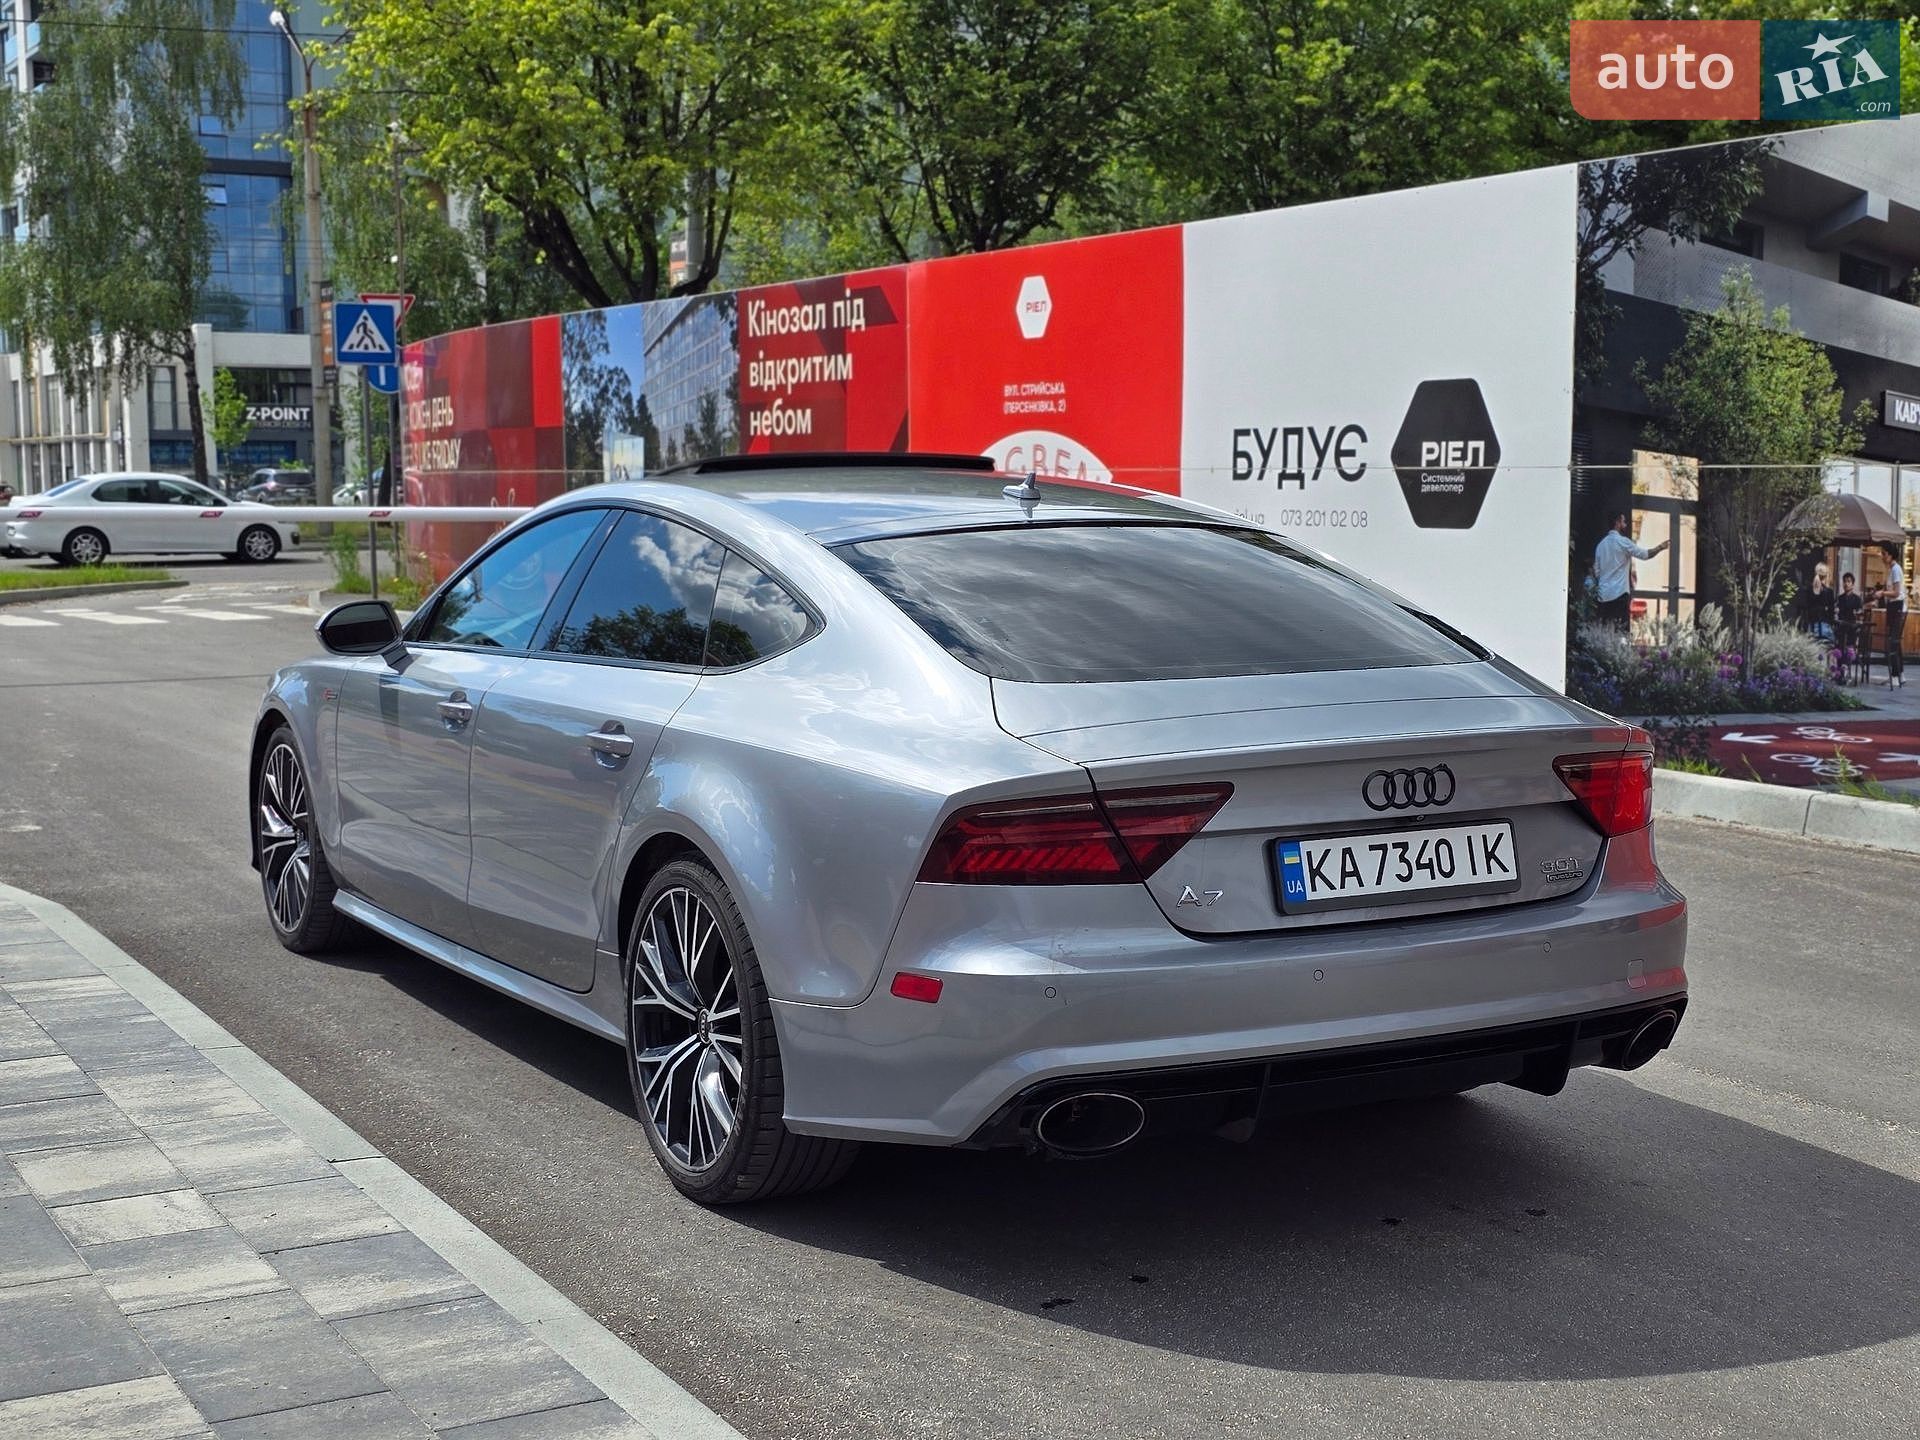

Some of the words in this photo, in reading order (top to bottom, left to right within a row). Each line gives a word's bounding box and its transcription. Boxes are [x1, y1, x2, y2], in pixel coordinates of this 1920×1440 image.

[748, 299, 826, 337] Кінозал
[833, 288, 866, 333] під
[749, 350, 853, 395] відкритим
[750, 398, 812, 436] небом
[1232, 424, 1368, 490] БУДУЄ
[1421, 440, 1485, 468] РІЕЛ
[1421, 472, 1465, 484] Системний
[1421, 484, 1464, 494] девелопер
[1281, 509, 1302, 526] 073
[1305, 510, 1326, 527] 201
[1331, 510, 1347, 527] 02
[1351, 511, 1368, 528] 08
[1177, 885, 1224, 907] A7
[1286, 880, 1304, 894] UA
